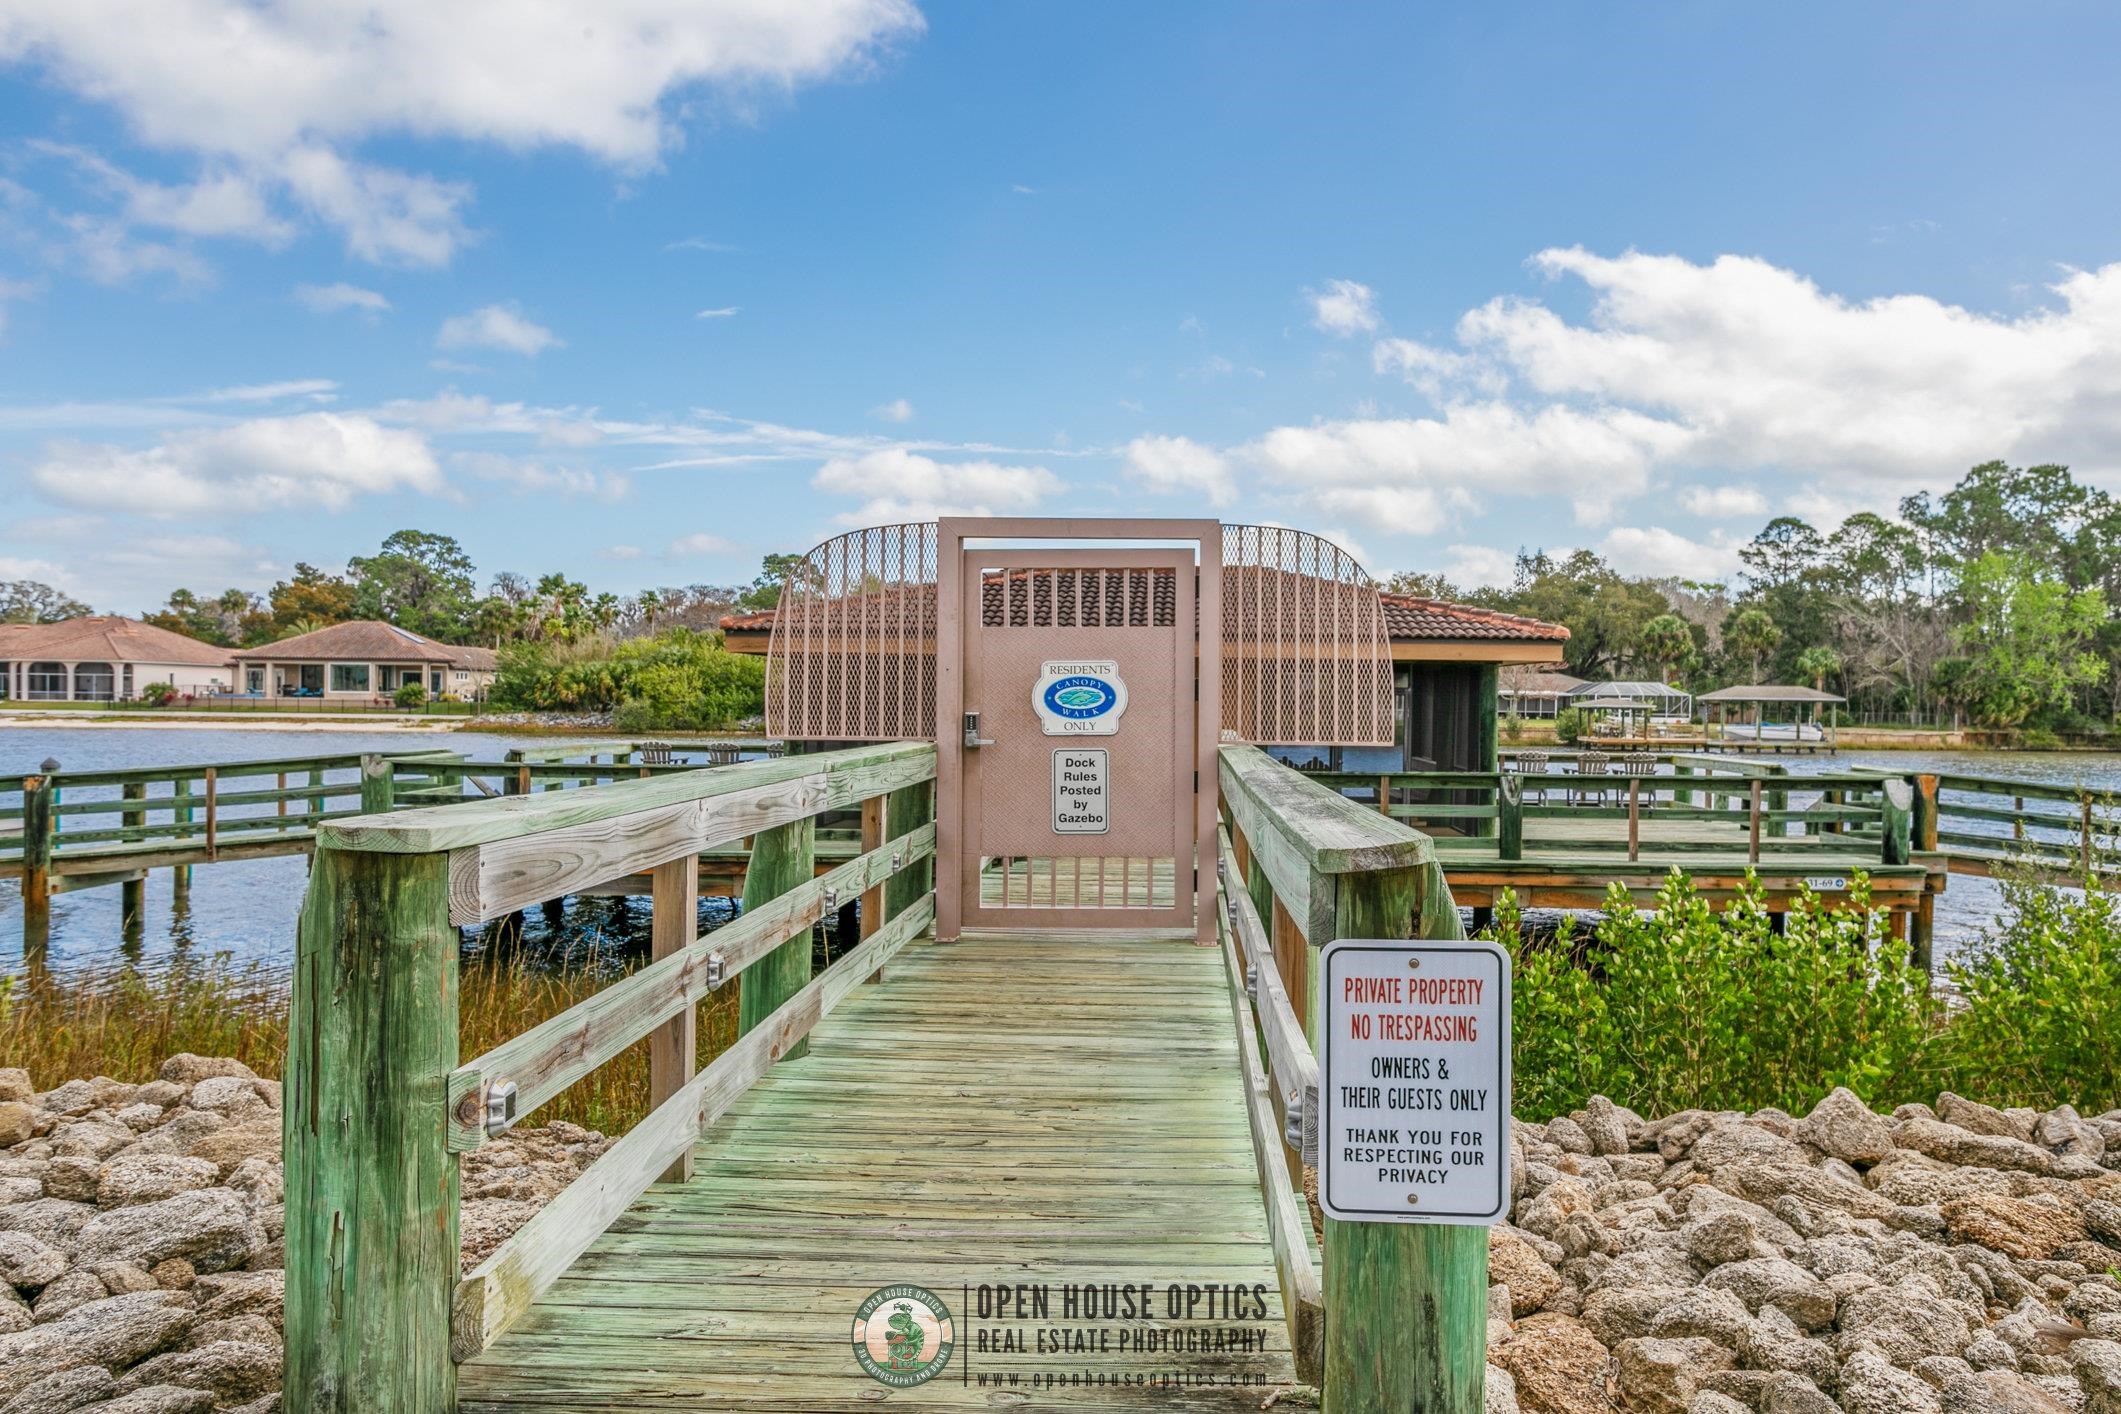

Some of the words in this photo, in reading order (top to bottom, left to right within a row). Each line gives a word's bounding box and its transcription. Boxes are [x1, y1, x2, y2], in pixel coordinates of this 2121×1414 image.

[1050, 665, 1111, 675] RESIDENTS
[1056, 679, 1104, 689] CANOPY
[1062, 707, 1099, 717] WALK
[1064, 722, 1096, 731] ONLY
[1065, 758, 1096, 767] Dock
[1064, 772, 1097, 781] Rules
[1060, 786, 1101, 795] Posted
[1073, 799, 1088, 811] by
[1058, 813, 1103, 823] Gazebo
[1345, 977, 1401, 1003] PRIVATE
[1409, 978, 1483, 1005] PROPERTY
[1351, 1014, 1371, 1040] NO
[1378, 1014, 1477, 1042] TRESPASSING
[1371, 1057, 1430, 1079] OWNERS
[1438, 1058, 1449, 1080] &
[1341, 1086, 1381, 1109] THEIR
[1388, 1087, 1442, 1110] GUESTS
[1450, 1089, 1488, 1111] ONLY
[1346, 1128, 1400, 1144] THANK
[1408, 1130, 1442, 1145] YOU
[1451, 1131, 1482, 1146] FOR
[1343, 1148, 1442, 1165] RESPECTING
[1451, 1151, 1484, 1166] OUR
[1378, 1168, 1448, 1184] PRIVACY
